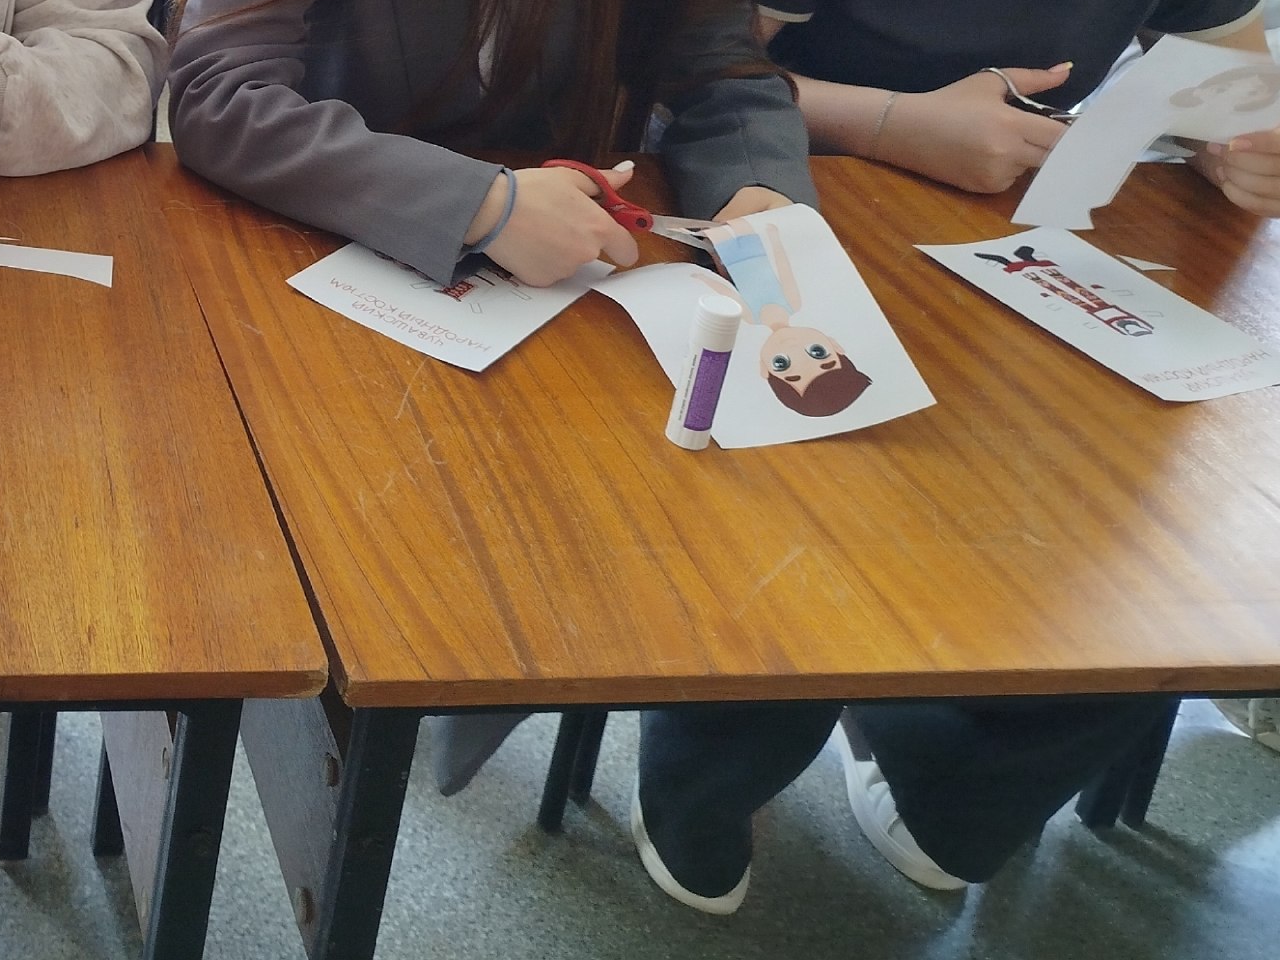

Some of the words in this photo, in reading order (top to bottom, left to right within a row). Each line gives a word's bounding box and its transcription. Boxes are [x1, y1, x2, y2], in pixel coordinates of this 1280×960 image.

[330, 277, 398, 313] КОСТЮМ
[352, 300, 444, 347] ЧУВАШСКИЙ
[398, 309, 493, 352] НАРОДНЫЙ
